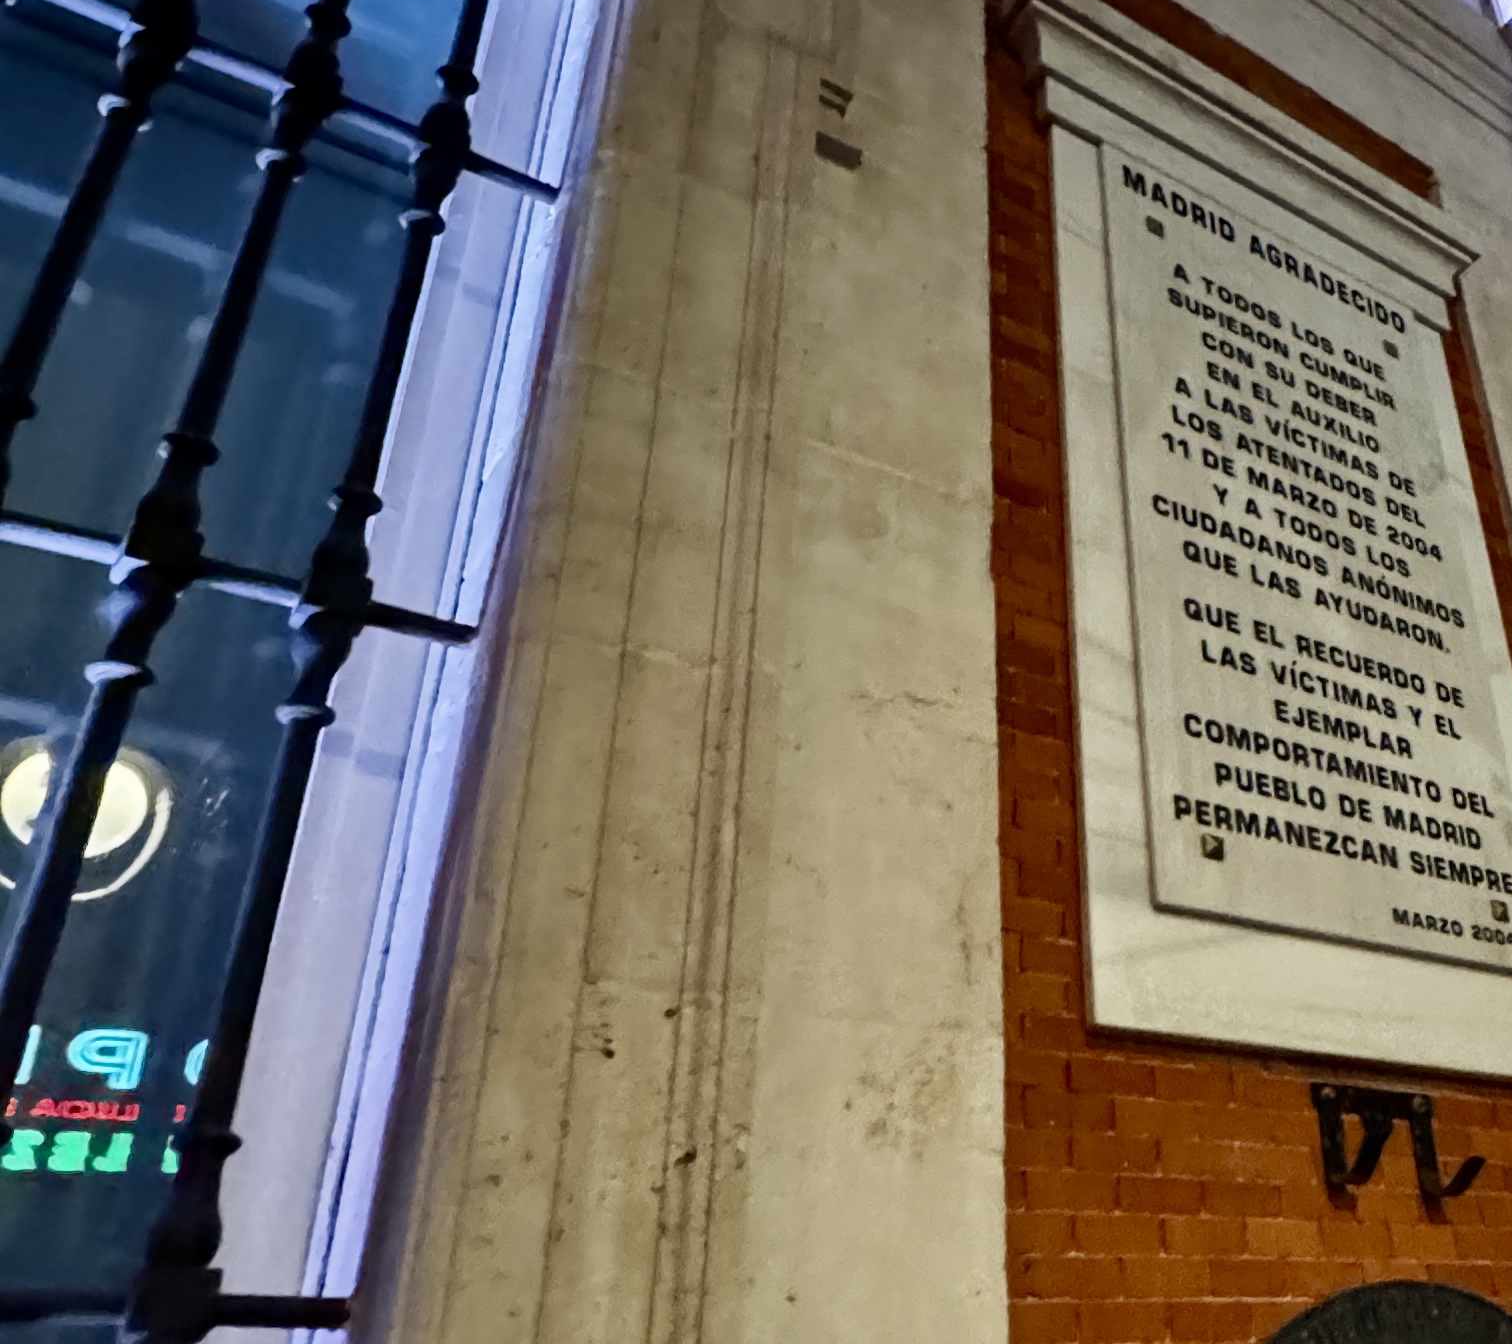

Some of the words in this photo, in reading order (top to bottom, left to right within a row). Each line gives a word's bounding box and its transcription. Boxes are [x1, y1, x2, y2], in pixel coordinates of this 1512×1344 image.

[1122, 165, 1235, 242] MADRID
[1249, 235, 1406, 334] AGRADECIDO
[1167, 287, 1289, 360] SUPIERON
[1299, 352, 1396, 411] CUMPLIR
[1173, 263, 1190, 284] A
[1200, 276, 1282, 329] TODOS
[1291, 321, 1335, 356] LOS
[1343, 349, 1386, 382] QUE
[1201, 331, 1255, 369] CON
[1264, 361, 1296, 388] SU
[1304, 379, 1377, 427] DEBER
[1206, 361, 1241, 391] EN
[1251, 381, 1279, 408] EL
[1291, 400, 1381, 454] AUXILIO
[1171, 404, 1223, 442] LOS
[1236, 432, 1377, 507] ATENTADOS
[1384, 496, 1426, 529] DEL
[1175, 377, 1192, 399] A
[1204, 388, 1254, 425] LAS
[1265, 415, 1379, 481] VÍCTIMAS
[1388, 471, 1416, 497] DE
[1161, 432, 1191, 460] 11
[1201, 447, 1237, 479] DE
[1246, 466, 1338, 518] MARZO
[1347, 508, 1378, 536] DE
[1386, 525, 1443, 562] 2004
[1212, 484, 1228, 506] Y
[1244, 497, 1262, 520] A
[1273, 508, 1357, 556] TODOS
[1365, 545, 1411, 578] LOS
[1152, 494, 1329, 577] CIUDADANOS
[1342, 565, 1465, 629] ANÓNIMOS
[1182, 540, 1239, 578] QUE
[1250, 563, 1302, 600] LAS
[1183, 598, 1241, 635] QUE
[1253, 619, 1285, 649] EL
[1294, 634, 1426, 695] RECUERDO
[1434, 681, 1465, 709] DE
[1201, 639, 1257, 676] LAS
[1268, 660, 1398, 720] VÍCTIMAS
[1406, 705, 1422, 728] Y
[1434, 714, 1461, 740] EL
[1183, 713, 1442, 803] COMPORTAMIENTO
[1451, 787, 1495, 819] DEL
[1273, 699, 1412, 759] EJEMPLAR
[1173, 794, 1399, 869] PERMANEZCAN
[1214, 762, 1327, 811] PUEBLO
[1338, 793, 1373, 823] DE
[1382, 805, 1482, 850] MADRID
[1392, 908, 1464, 938] MARZO
